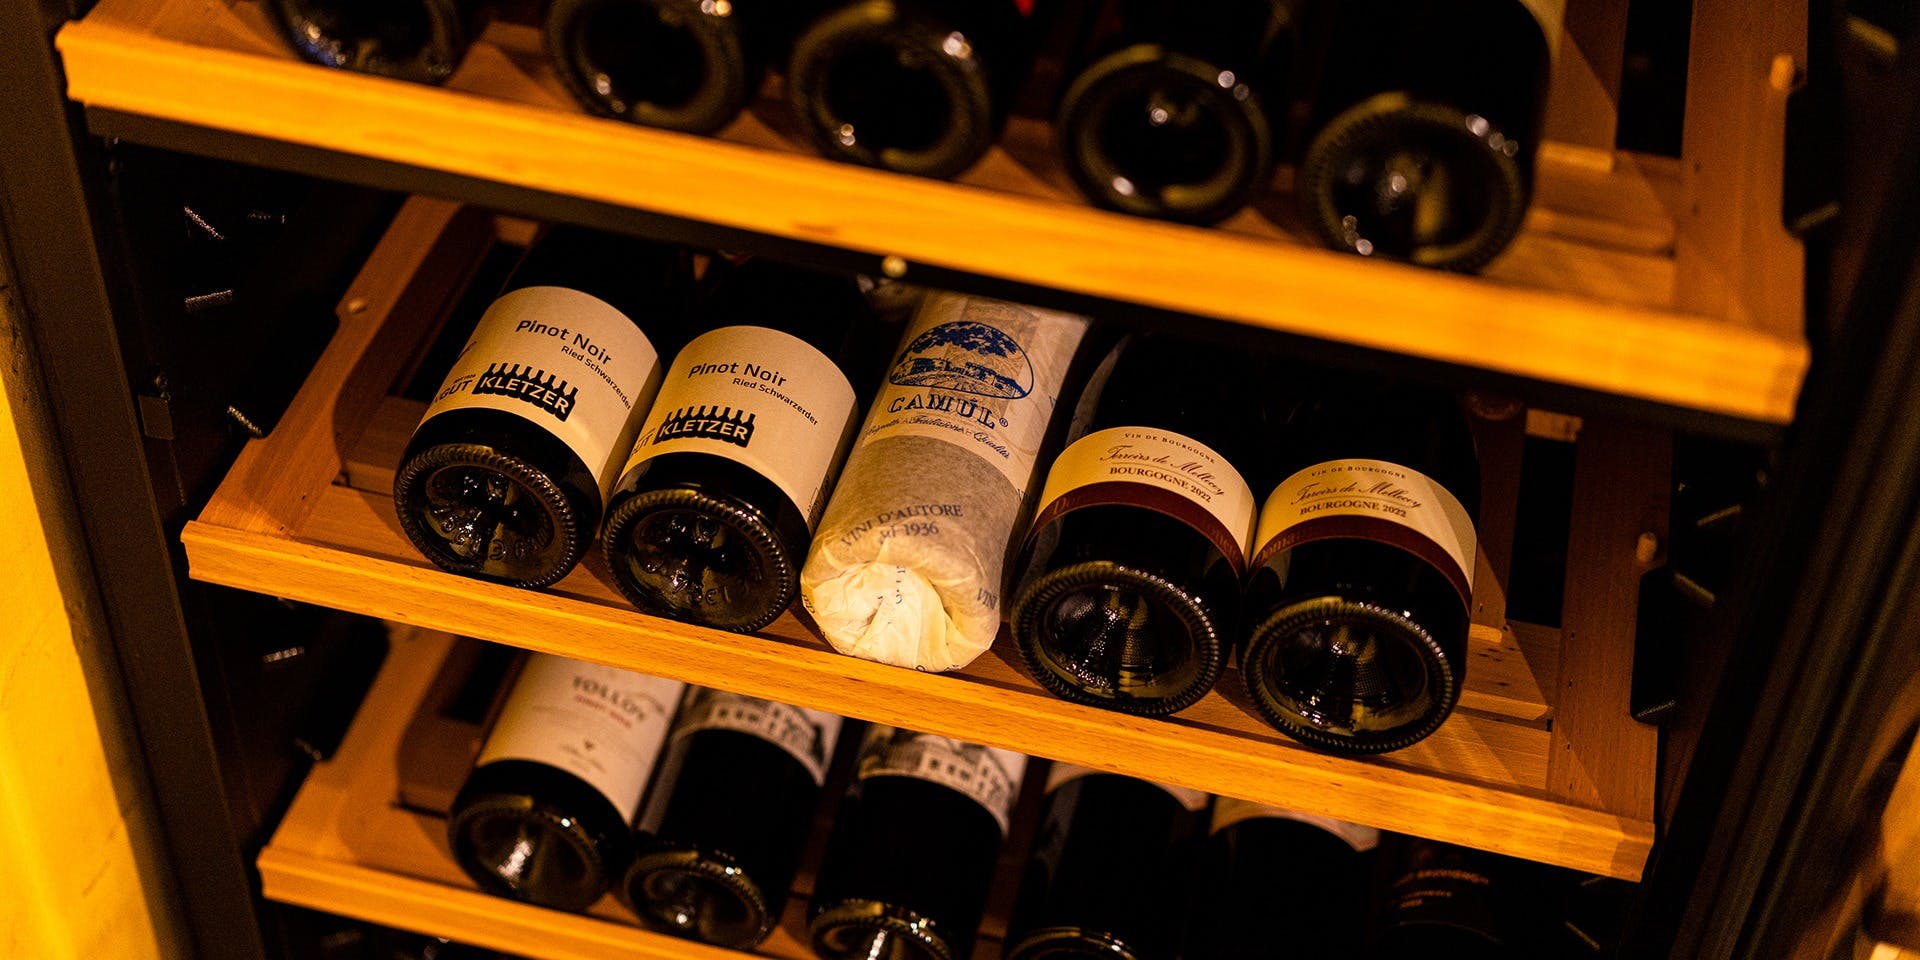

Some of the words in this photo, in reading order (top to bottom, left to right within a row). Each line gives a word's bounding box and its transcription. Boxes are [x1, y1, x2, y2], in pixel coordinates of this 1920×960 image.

[516, 320, 570, 341] Pinot
[572, 332, 612, 365] Noir
[561, 345, 584, 362] Ried
[584, 358, 632, 410] Schwarzerder
[687, 362, 739, 379] Pinot
[743, 363, 787, 387] Noir
[479, 376, 569, 415] KLETZER
[732, 377, 757, 389] Ried
[758, 383, 818, 426] Schwarzerder
[659, 419, 749, 441] KLETZER
[1152, 455, 1170, 465] de
[1161, 436, 1216, 465] BOURGOGNE
[1109, 466, 1189, 490] BOURGOGNE
[1190, 485, 1213, 503] 2022
[1311, 469, 1327, 477] VIN
[1347, 465, 1406, 480] BOURGOGNE
[1339, 481, 1358, 494] de
[1300, 499, 1380, 516] BOURGOGNE
[1382, 504, 1407, 518] 2022
[840, 520, 873, 547] VINI
[903, 521, 940, 538] 1936
